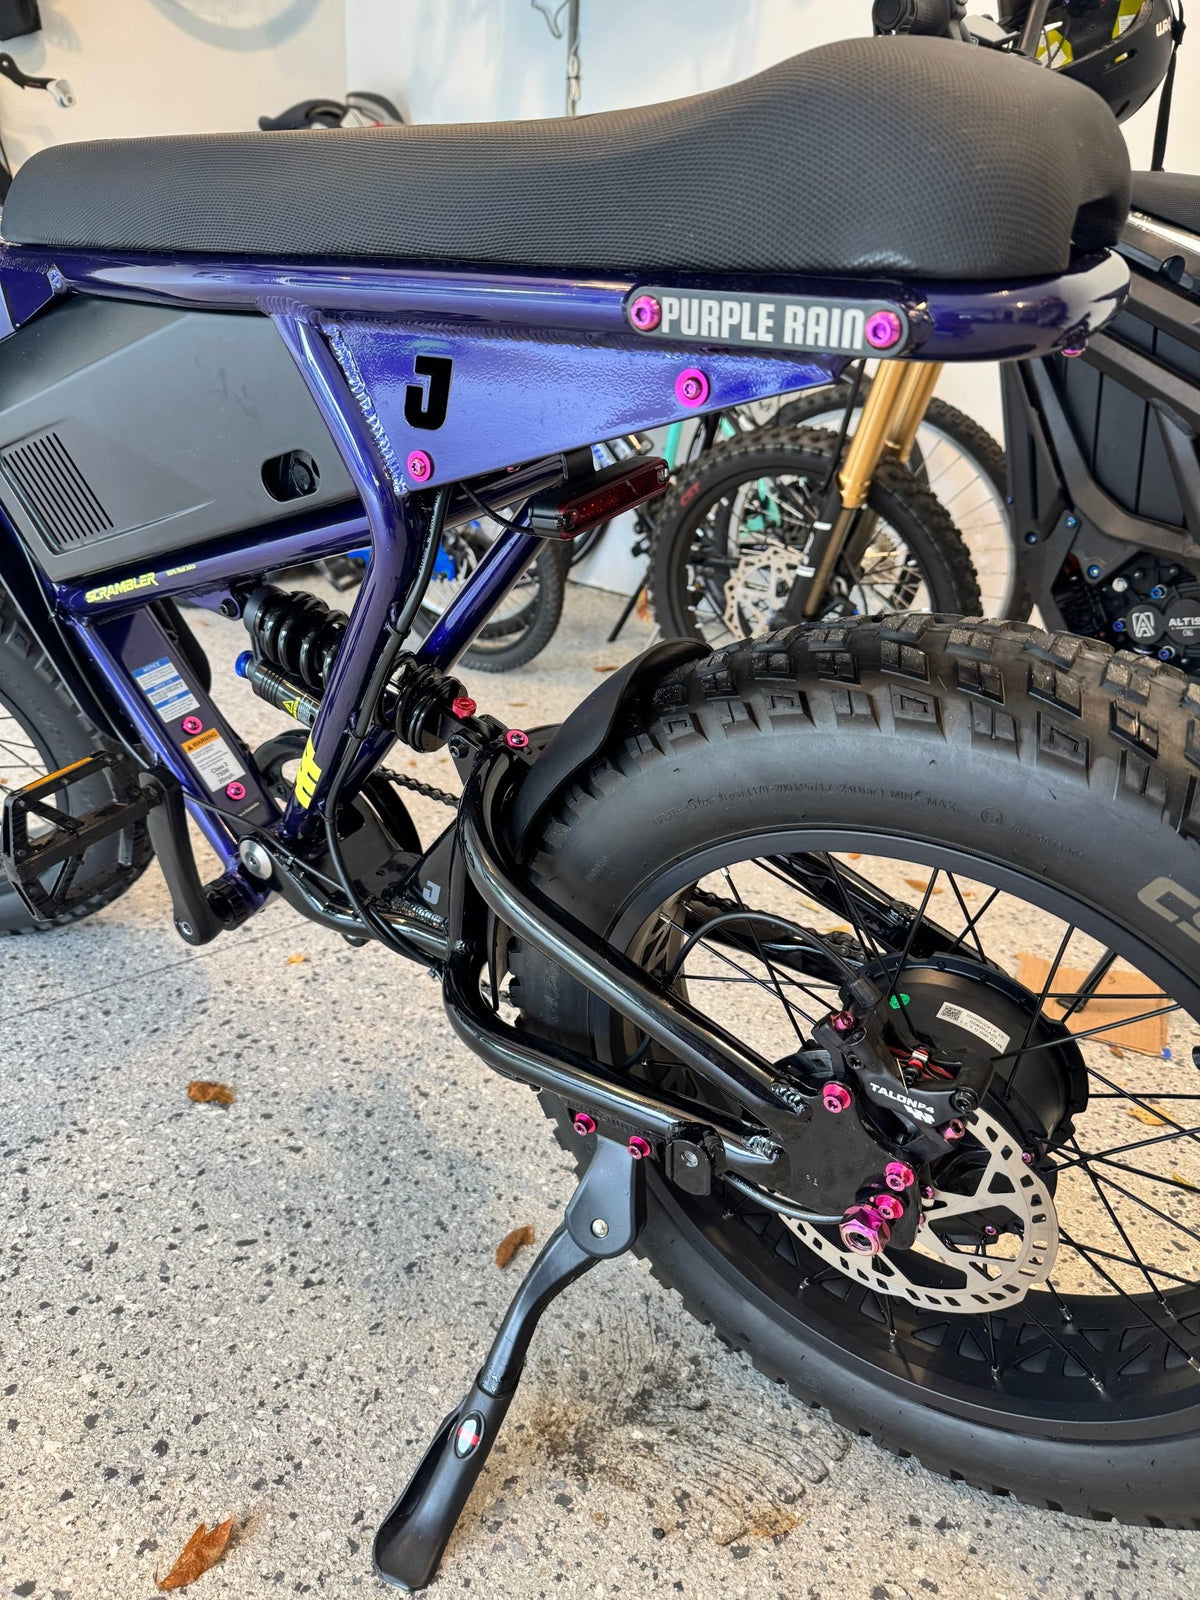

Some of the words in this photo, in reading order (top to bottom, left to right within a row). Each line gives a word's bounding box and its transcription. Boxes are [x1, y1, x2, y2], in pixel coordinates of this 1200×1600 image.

[661, 297, 776, 342] PURPLE
[783, 305, 866, 349] RAIN
[404, 355, 453, 431] J
[85, 572, 159, 604] SCRAMBLER
[191, 731, 218, 748] WARNING
[422, 880, 441, 905] J
